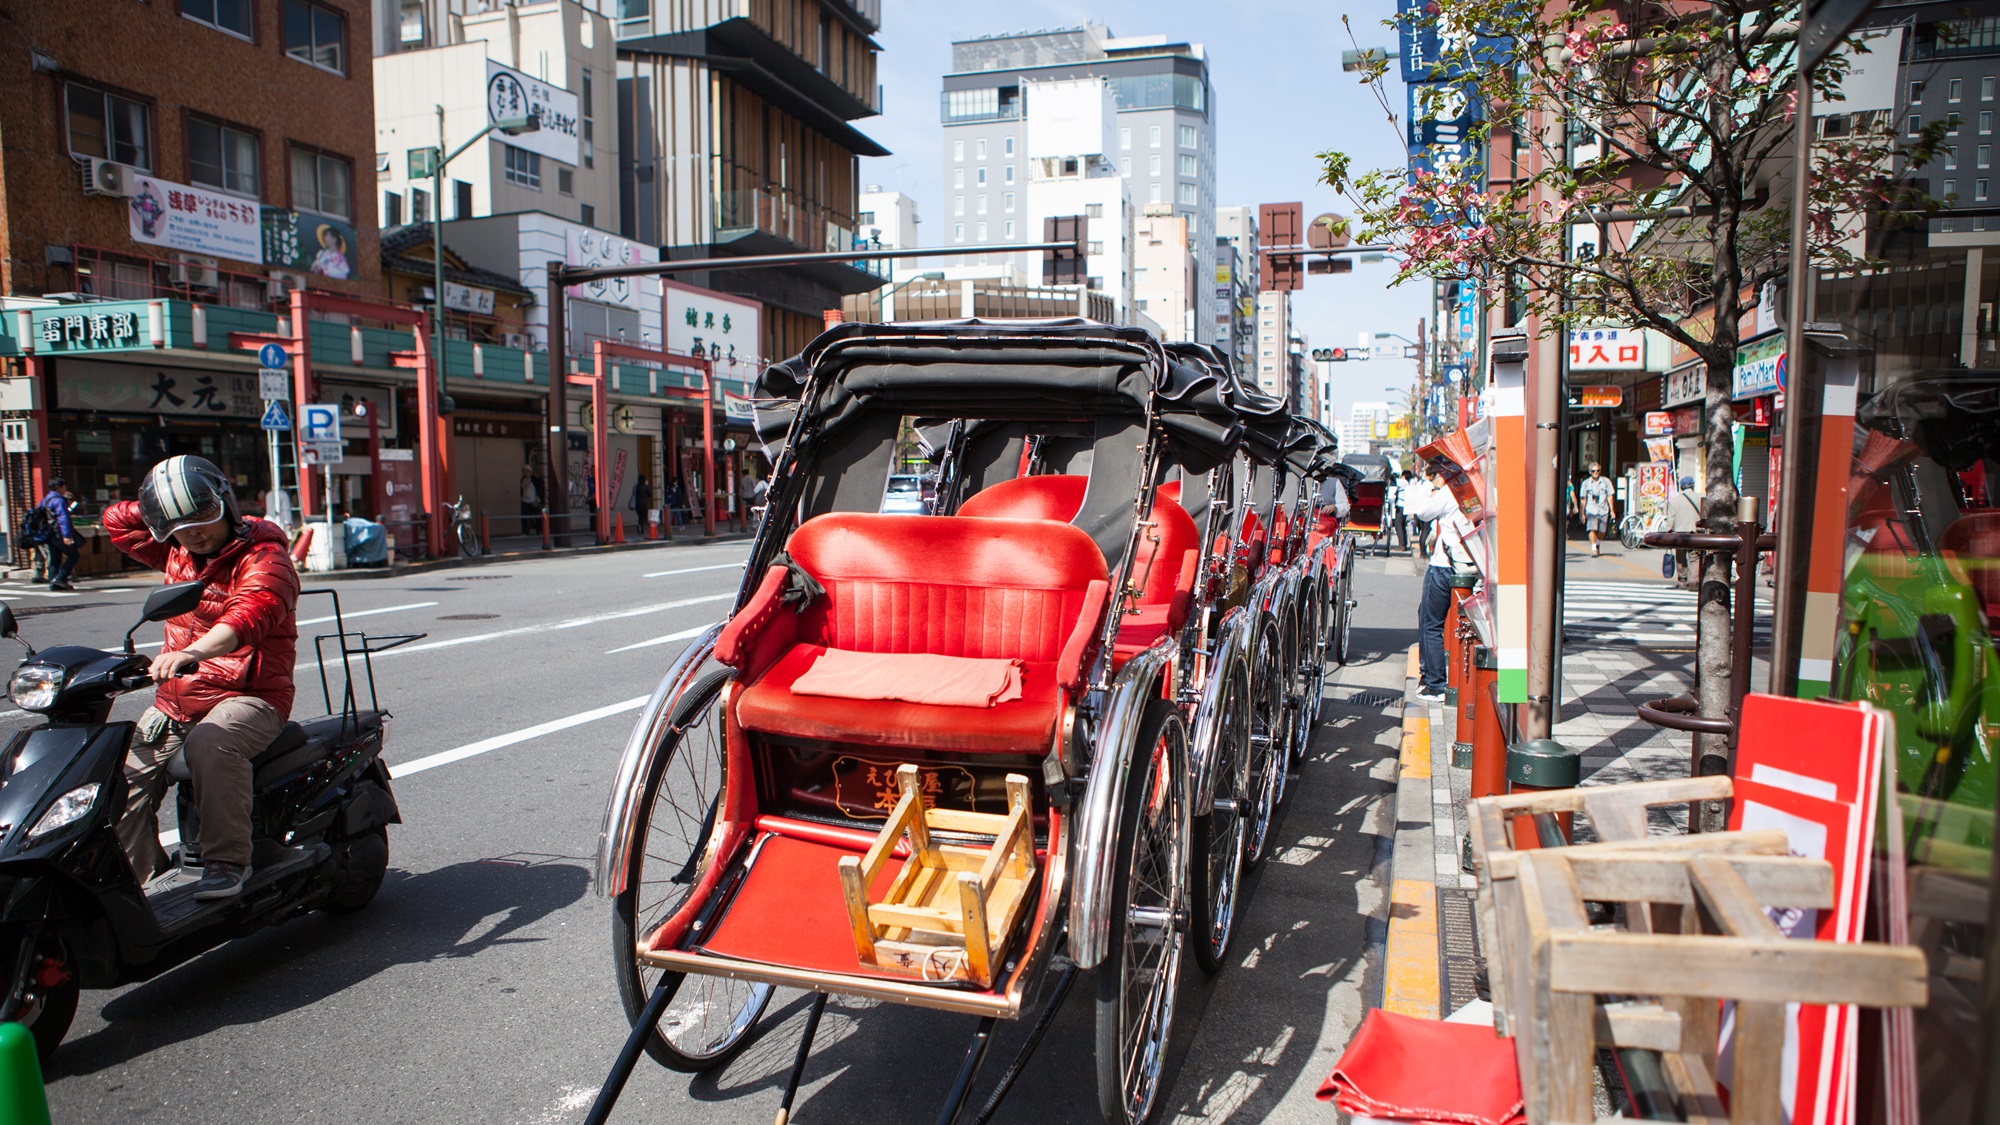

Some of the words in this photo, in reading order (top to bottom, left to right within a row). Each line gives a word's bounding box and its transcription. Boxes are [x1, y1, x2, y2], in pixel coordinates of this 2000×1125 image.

[41, 311, 133, 342] 雷門東部
[1740, 361, 1775, 390] FamilyMart
[149, 372, 227, 412] 大元
[307, 408, 333, 438] P
